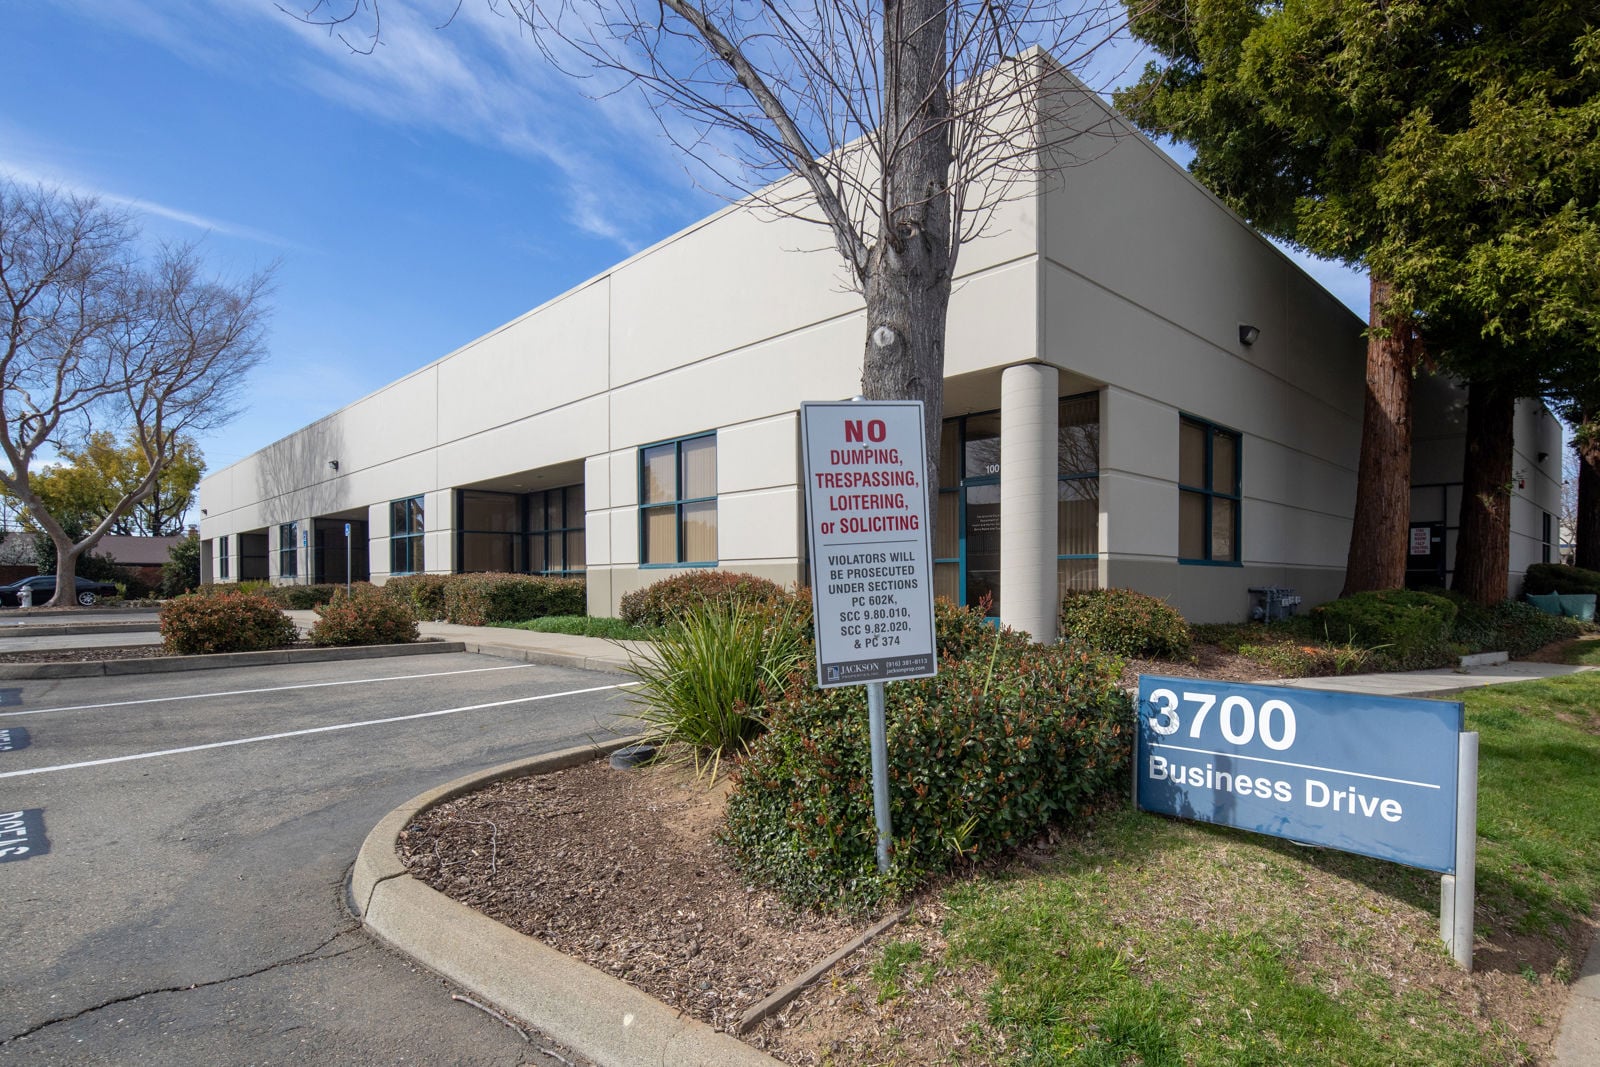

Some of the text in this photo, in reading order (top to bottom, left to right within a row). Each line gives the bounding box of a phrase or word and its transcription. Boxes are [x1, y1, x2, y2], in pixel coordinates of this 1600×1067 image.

[844, 419, 887, 443] NO
[830, 448, 903, 466] DUMPING,
[985, 464, 1000, 474] 100
[815, 470, 919, 489] TRESPASSING,
[829, 493, 909, 511] LOITERING,
[821, 515, 919, 535] or SOLICITING
[828, 551, 915, 566] VIOLATORS WILL
[830, 565, 915, 580] BE PROSECUTED
[828, 579, 918, 595] UNDER SECTIONS
[852, 594, 898, 607] PC 602K,
[839, 607, 911, 622] SCC 9.80.010,
[840, 621, 911, 636] SCC 9.82.020,
[854, 636, 900, 649] & PC 374
[840, 662, 879, 675] JACKSON
[1148, 688, 1297, 751] 3700
[1149, 755, 1403, 823] Business Drive
